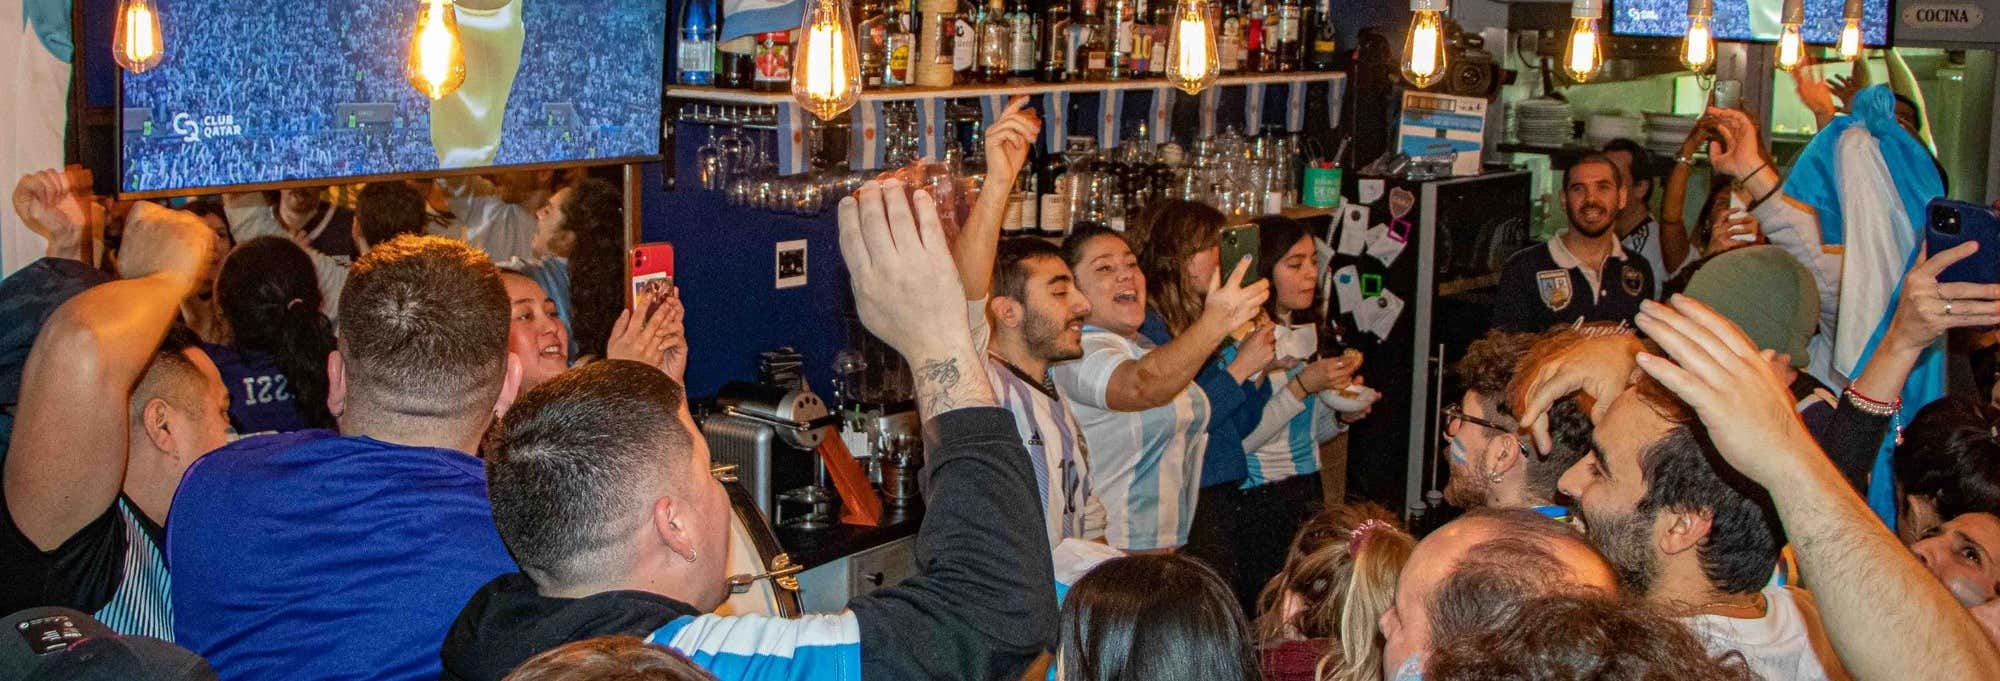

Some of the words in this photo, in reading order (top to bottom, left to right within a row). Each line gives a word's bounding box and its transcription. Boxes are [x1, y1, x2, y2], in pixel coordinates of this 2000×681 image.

[1917, 8, 1968, 22] COCINA
[204, 115, 234, 126] CLUB
[204, 125, 242, 138] QATAR
